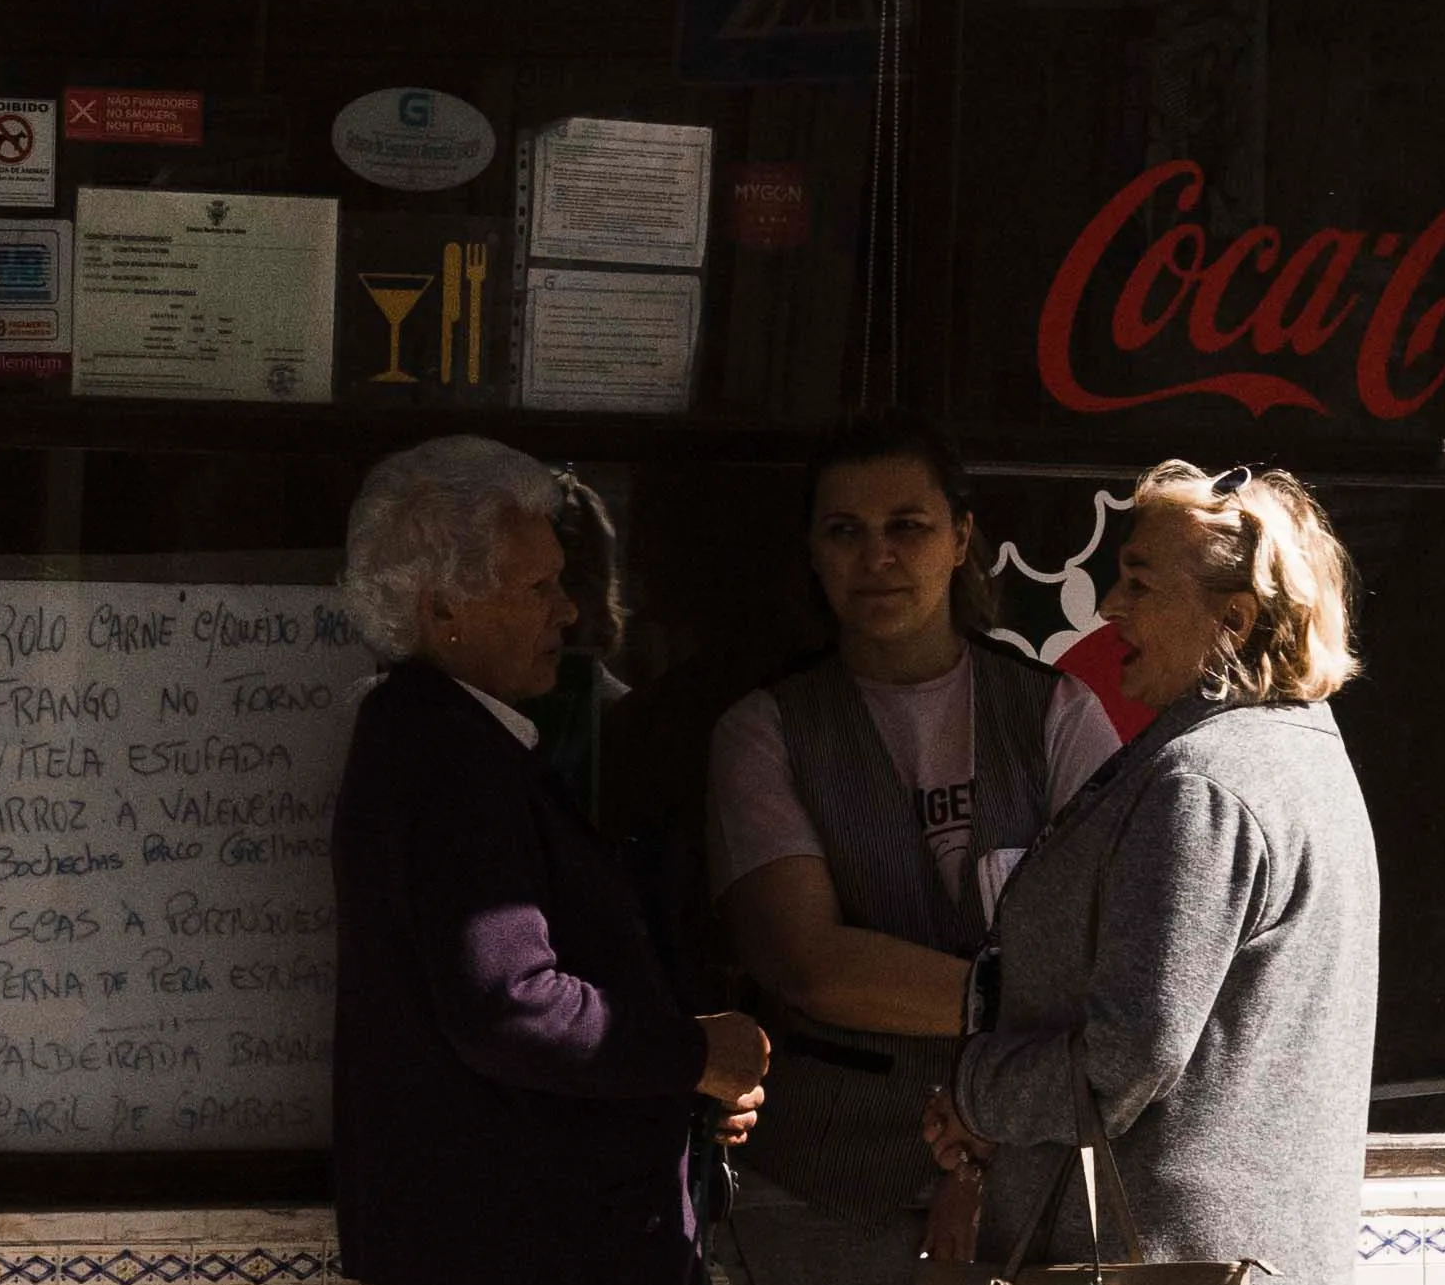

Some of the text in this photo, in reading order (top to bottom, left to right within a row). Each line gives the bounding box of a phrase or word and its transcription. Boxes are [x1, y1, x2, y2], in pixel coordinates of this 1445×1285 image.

[106, 95, 199, 109] NÃO FUMADORES
[106, 109, 178, 121] NO SMOKERS
[132, 122, 184, 133] FUMEURS
[159, 686, 199, 723] NO
[222, 671, 333, 718] FORNO
